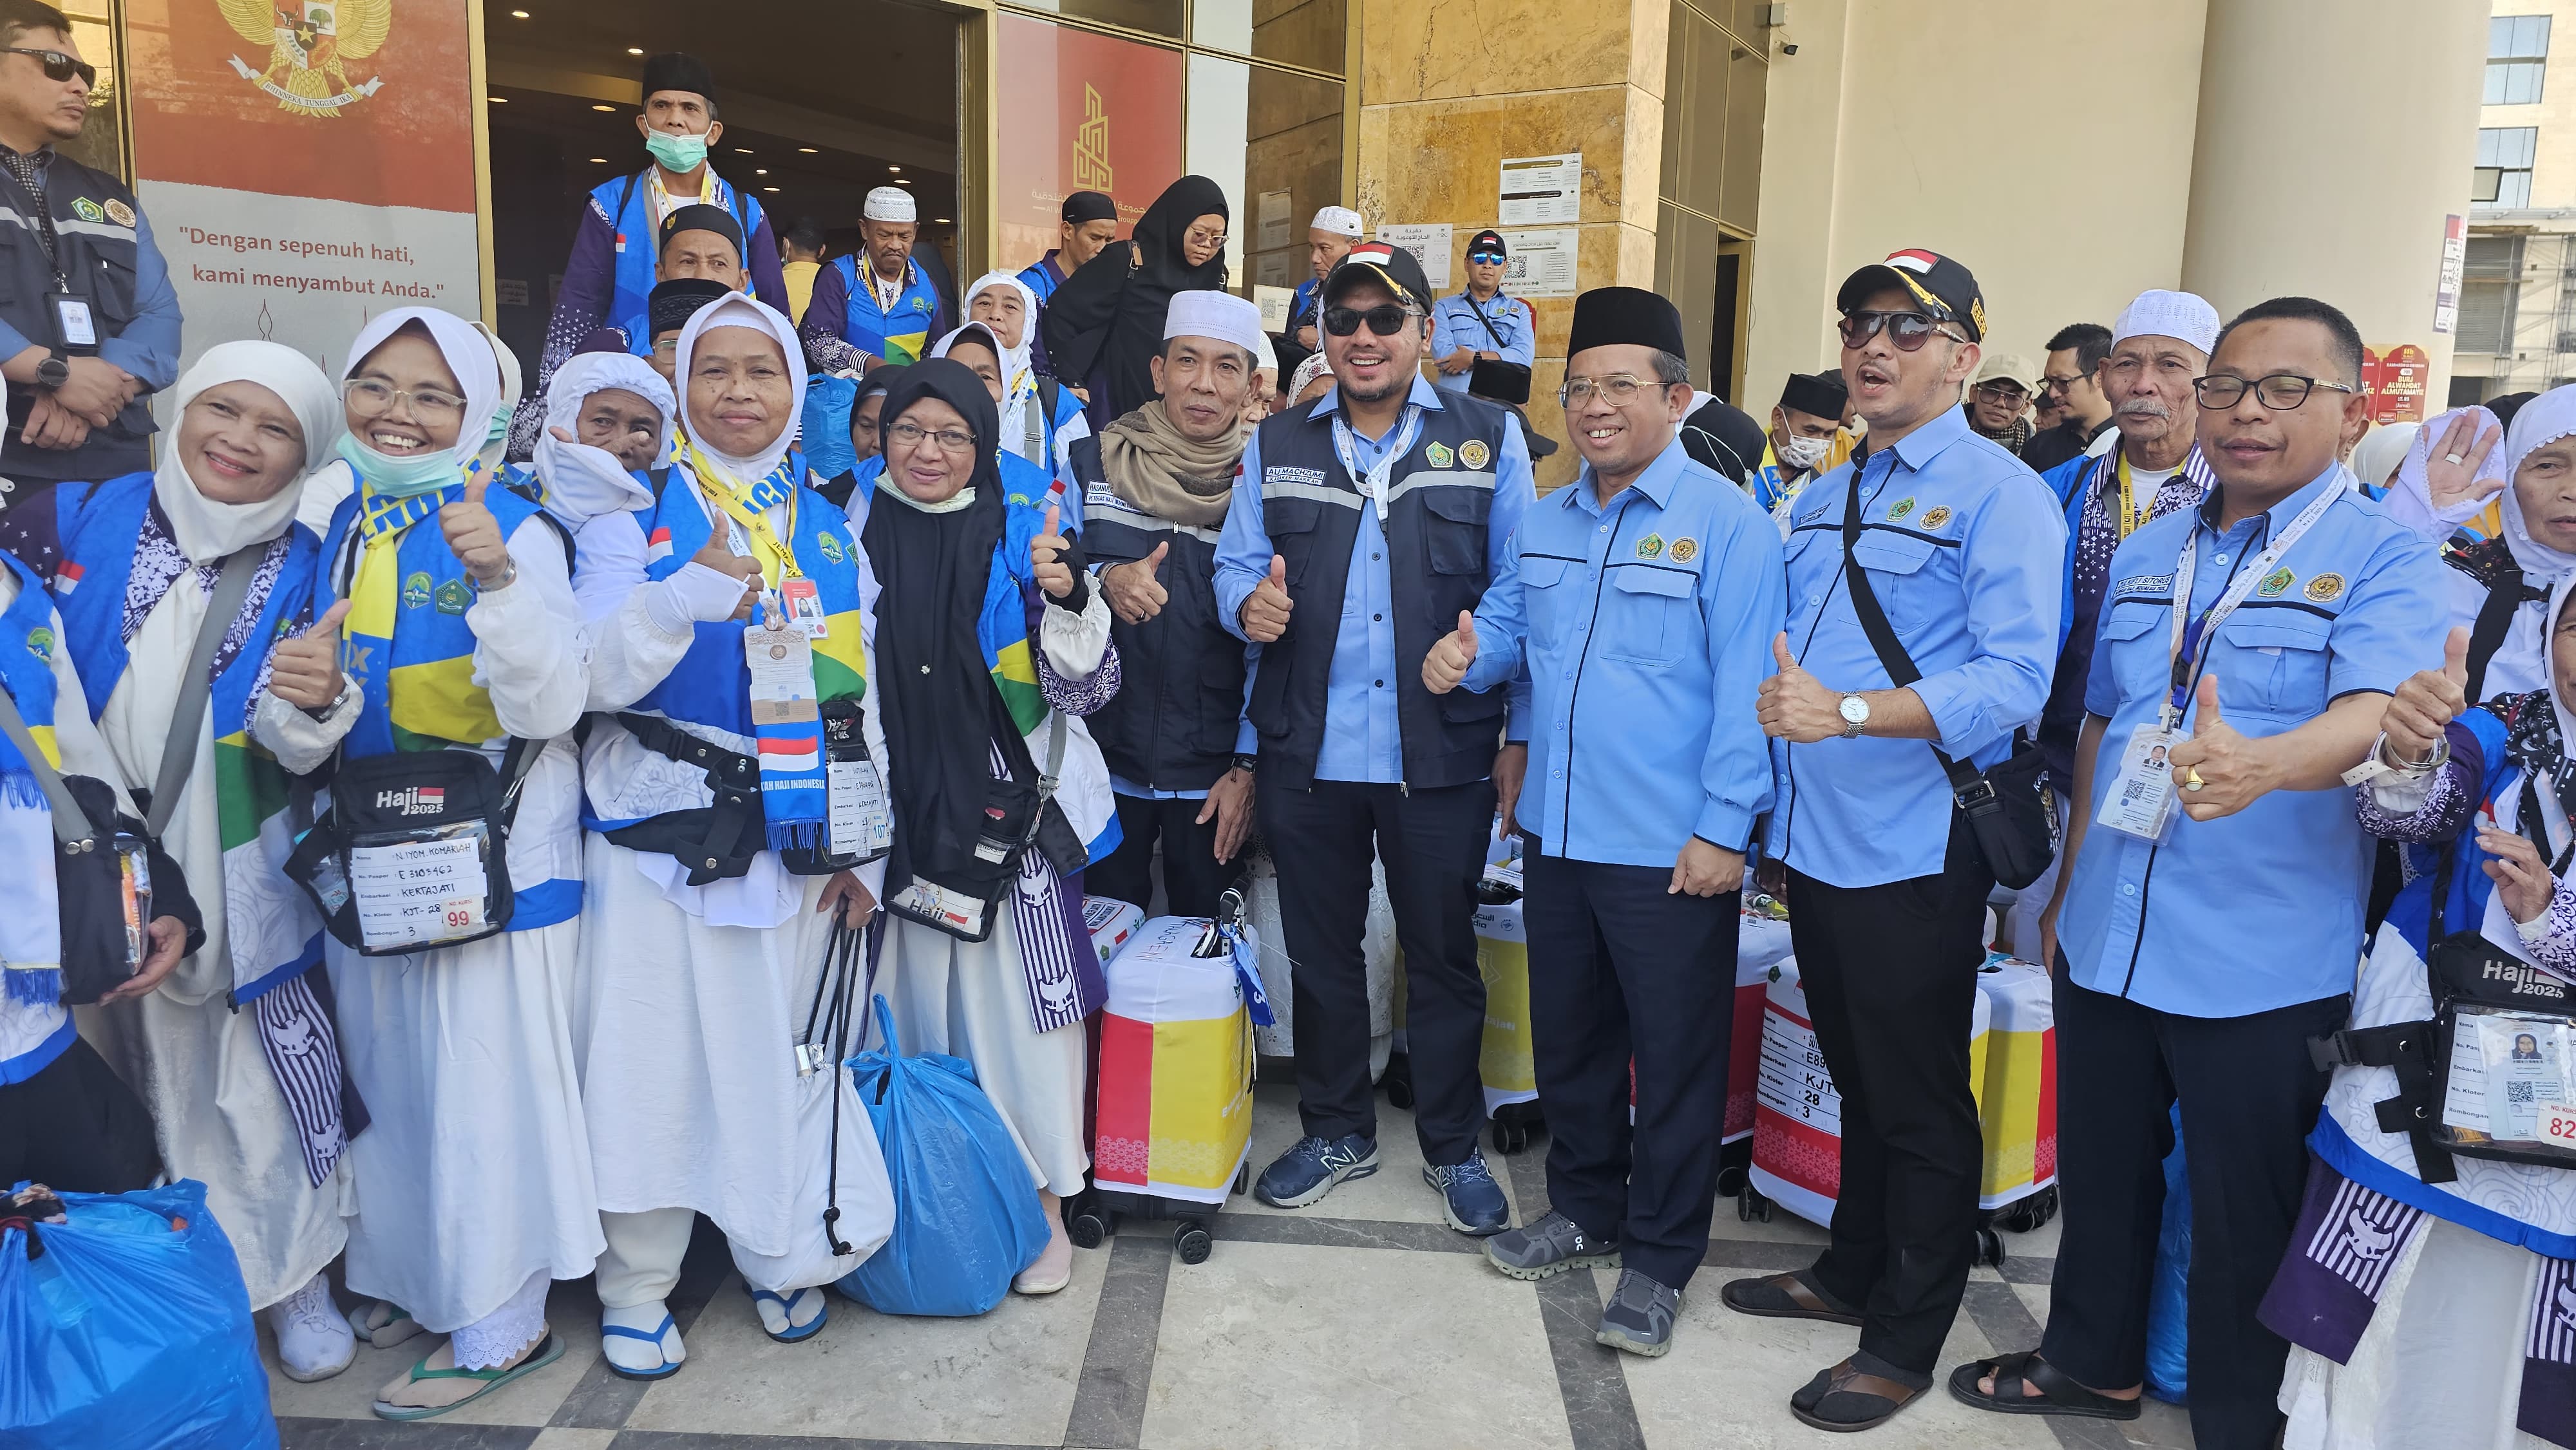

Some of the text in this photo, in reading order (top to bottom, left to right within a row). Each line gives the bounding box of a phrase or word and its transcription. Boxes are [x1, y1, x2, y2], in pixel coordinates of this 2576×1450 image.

[265, 83, 301, 104] BHINNEKA
[340, 94, 352, 103] IKA
[179, 226, 415, 266] "Dengan sepenuh hati,
[193, 264, 444, 299] kami menyambut Anda."
[1282, 468, 1323, 478] MACHZUMI
[775, 780, 791, 790] HAJI
[791, 778, 825, 789] INDONESIA
[376, 787, 419, 815] Haji
[410, 804, 444, 814] 2025
[873, 824, 886, 839] 107
[401, 883, 455, 898] KERTAJATI
[428, 903, 441, 914] 28
[448, 910, 469, 927] 99
[1473, 920, 1487, 928] dia
[408, 926, 415, 936] 3
[2483, 960, 2535, 993] Haji
[2523, 983, 2564, 999] 2025
[1770, 1037, 1788, 1051] Paspor
[2454, 1064, 2488, 1075] Embarka
[1766, 1072, 1785, 1087] Kloter
[1805, 1072, 1834, 1094] KJT
[1804, 1089, 1821, 1106] 28
[2463, 1088, 2485, 1097] Kloter
[1803, 1105, 1810, 1118] 3
[2448, 1107, 2489, 1119] Rombongan
[2550, 1117, 2576, 1139] 82
